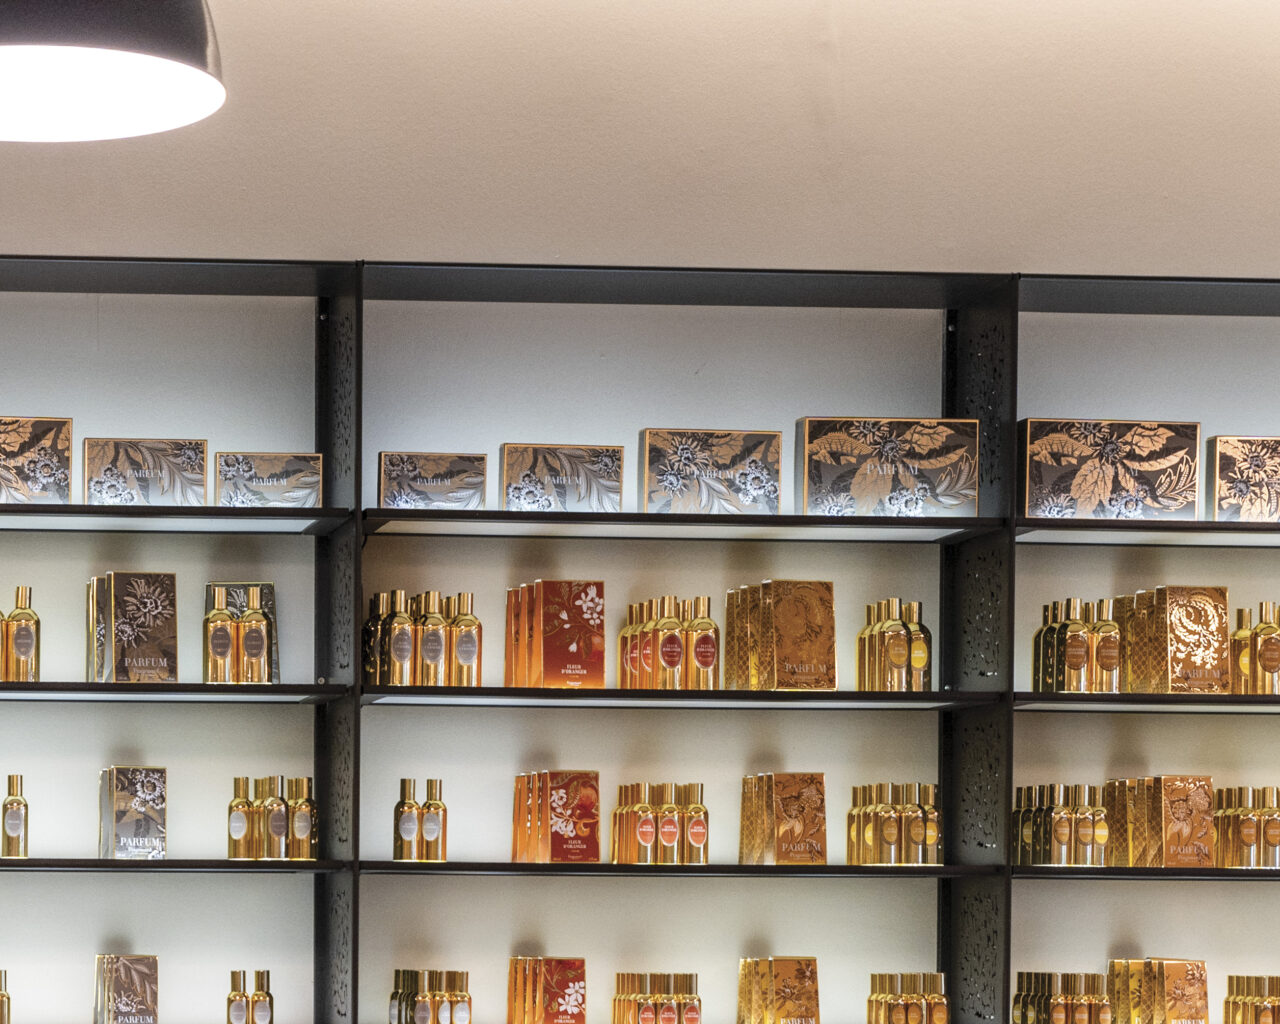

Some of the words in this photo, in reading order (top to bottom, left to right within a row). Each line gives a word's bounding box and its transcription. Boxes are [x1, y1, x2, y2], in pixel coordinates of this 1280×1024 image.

[127, 469, 166, 478] PARFUM
[866, 464, 919, 475] PARFUM
[694, 470, 734, 480] PARFUM
[253, 477, 287, 485] PARFUM
[417, 477, 451, 485] PARFUM
[545, 476, 583, 485] PARFUM
[124, 657, 168, 667] PARFUM
[783, 663, 828, 673] PARFUM
[120, 837, 160, 847] PARFUM
[782, 841, 821, 852] PARFUM
[1170, 844, 1209, 855] PARFUM
[118, 1015, 153, 1024] PARFUM
